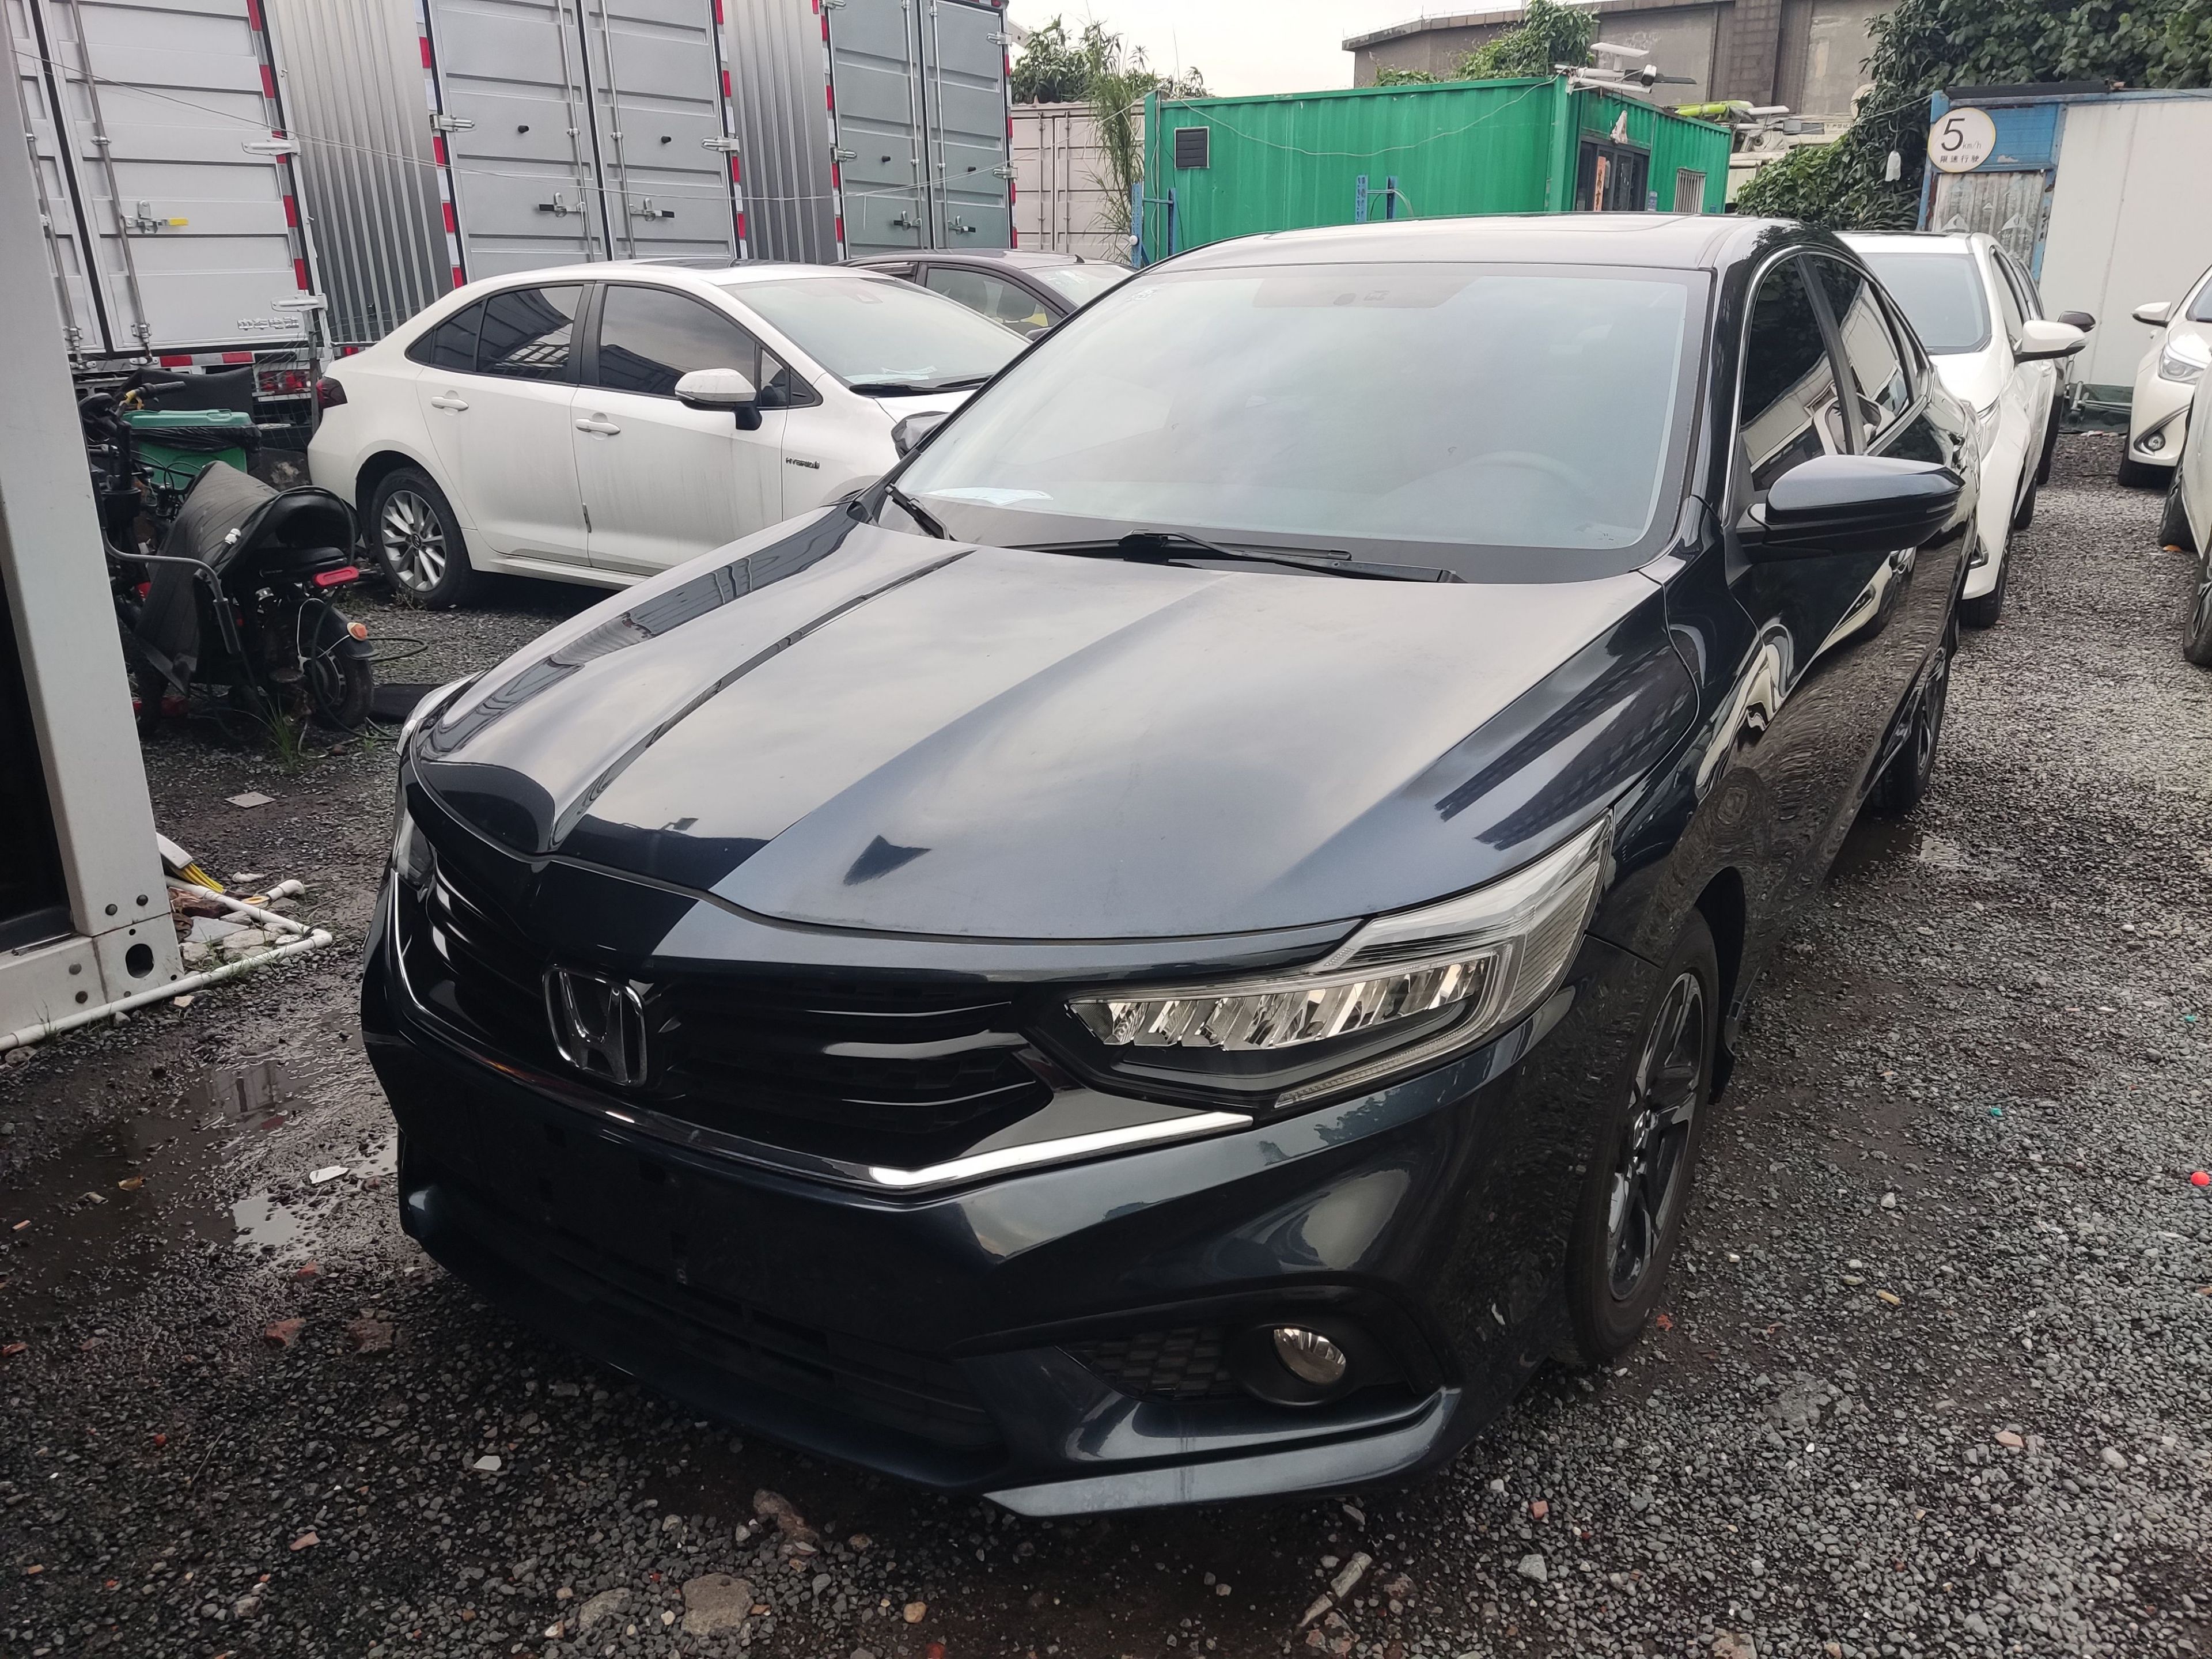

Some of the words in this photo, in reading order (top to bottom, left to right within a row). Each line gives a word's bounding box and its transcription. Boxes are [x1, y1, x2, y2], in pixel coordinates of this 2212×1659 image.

[1942, 118, 1965, 151] 5
[1963, 141, 1981, 149] km/h
[1940, 154, 1979, 163] 限速行驶
[785, 457, 815, 469] HYBRID
